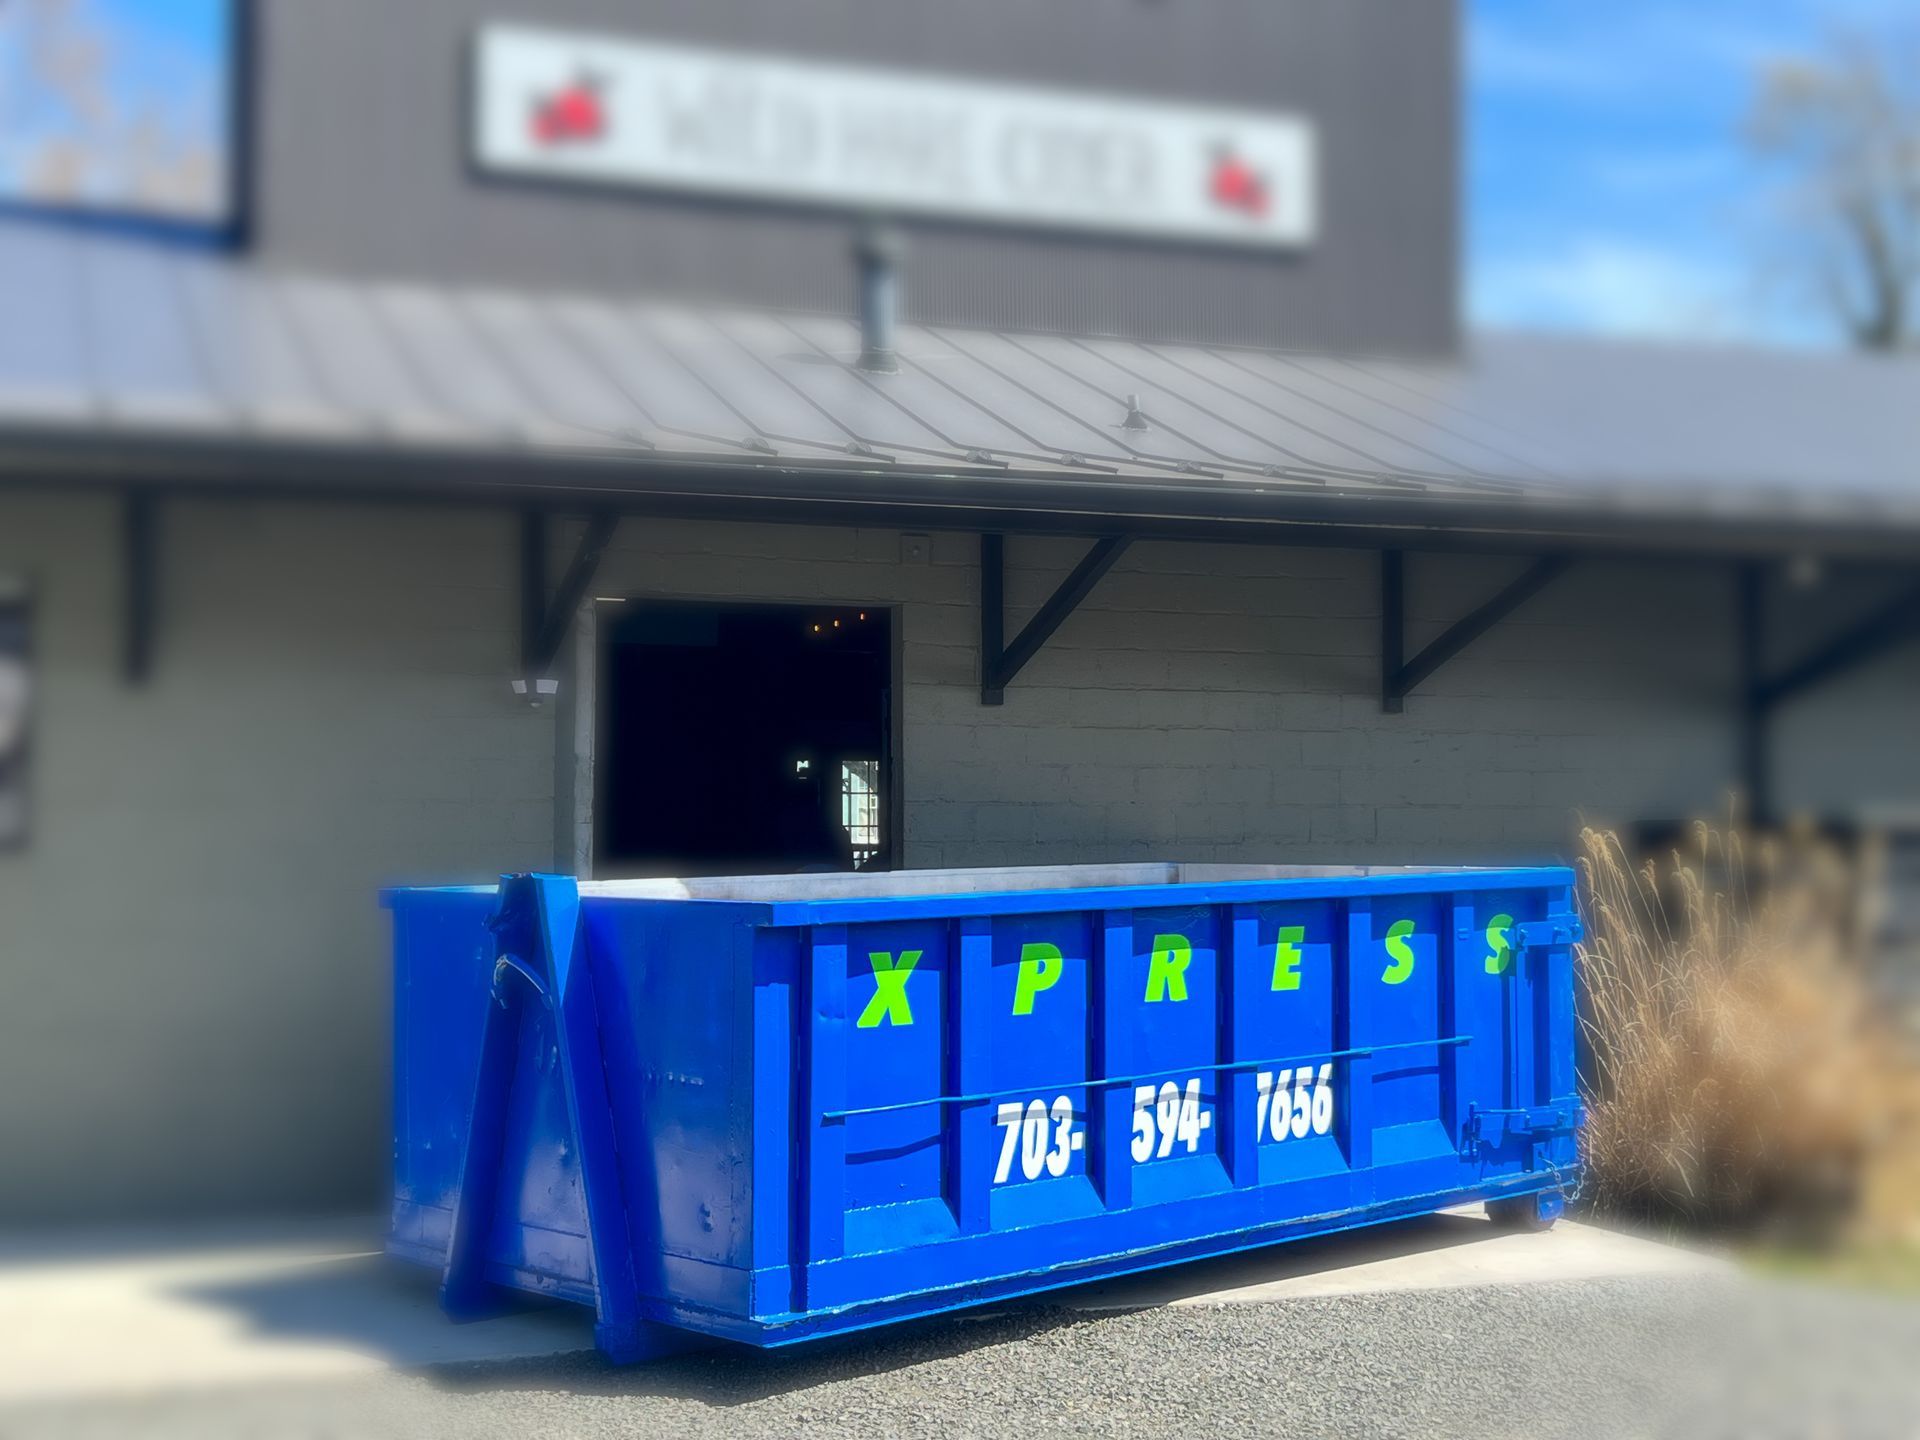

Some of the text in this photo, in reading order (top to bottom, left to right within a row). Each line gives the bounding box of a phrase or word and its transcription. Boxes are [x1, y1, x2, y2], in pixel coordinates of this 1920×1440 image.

[993, 1063, 1334, 1184] 703- 594- 7656
